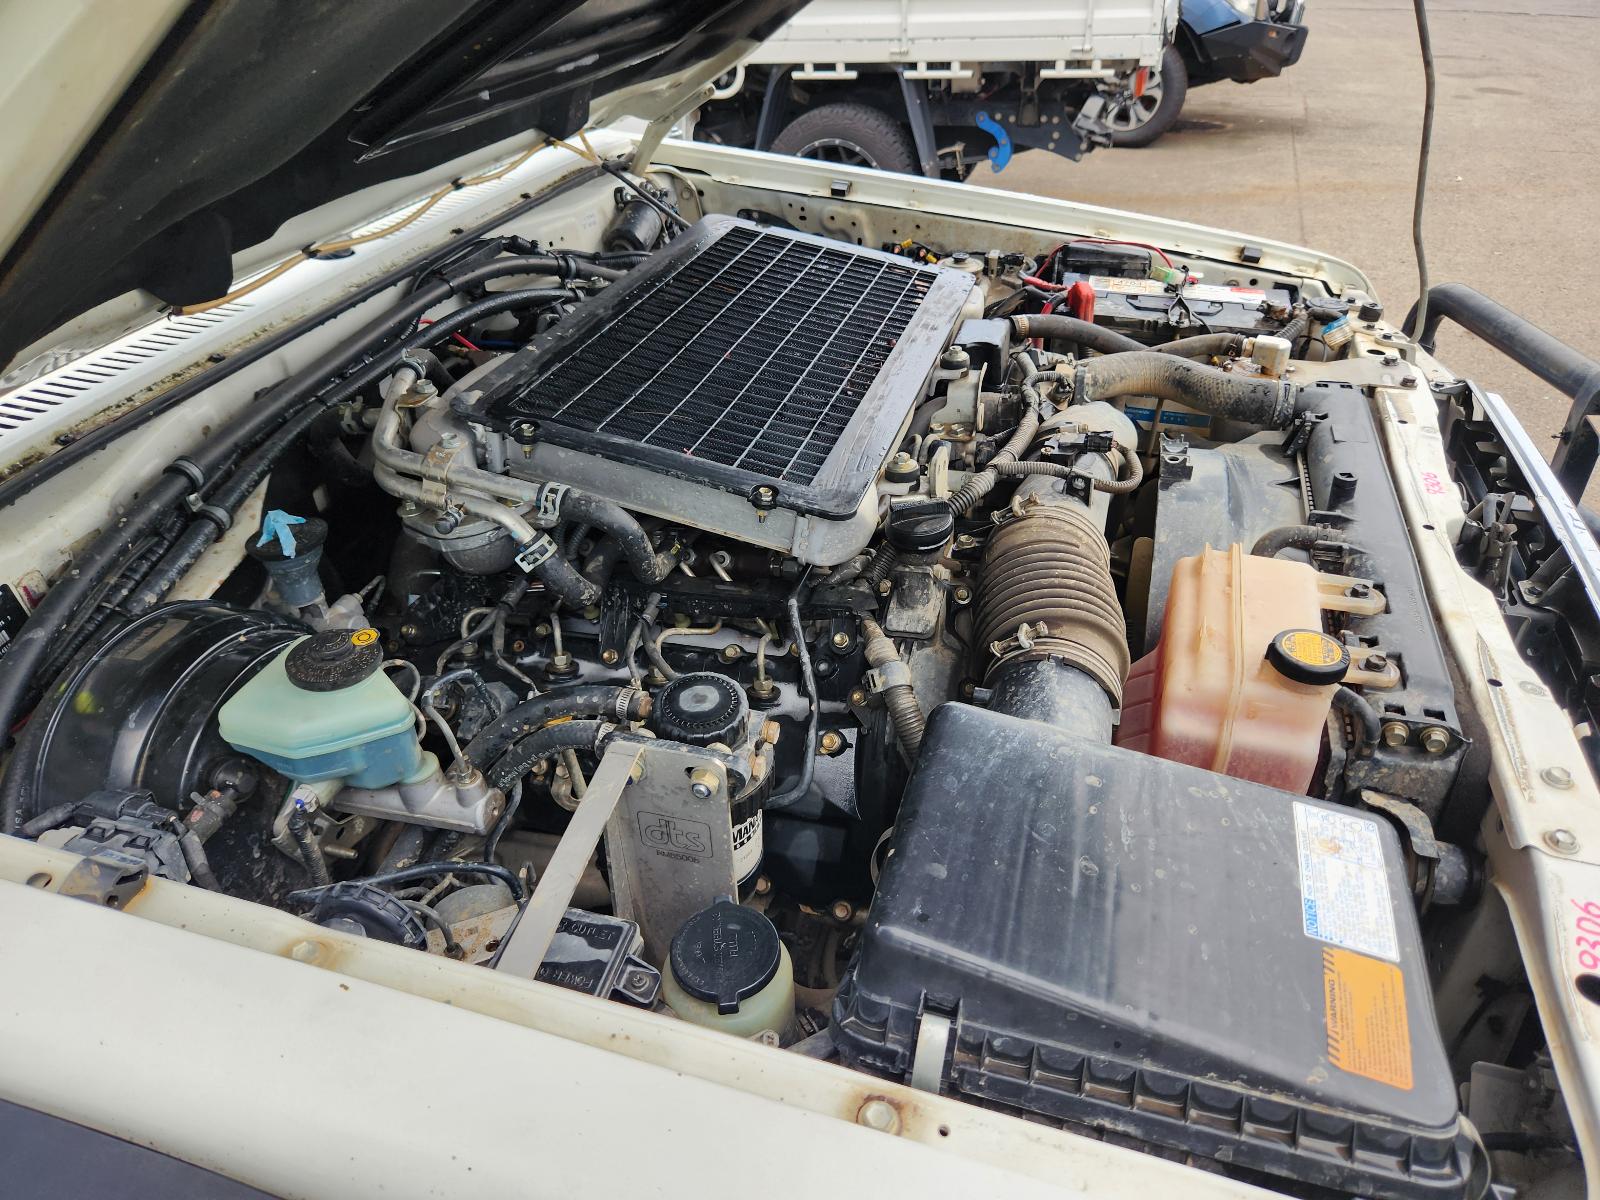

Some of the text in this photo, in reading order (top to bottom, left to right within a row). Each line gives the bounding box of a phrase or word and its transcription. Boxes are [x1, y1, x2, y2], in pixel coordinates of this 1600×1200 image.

[645, 819, 706, 852] dts
[571, 923, 616, 941] OUTLET
[1305, 898, 1319, 936] NOTICE
[1570, 899, 1600, 970] 9306
[1328, 978, 1337, 1029] WARNING
